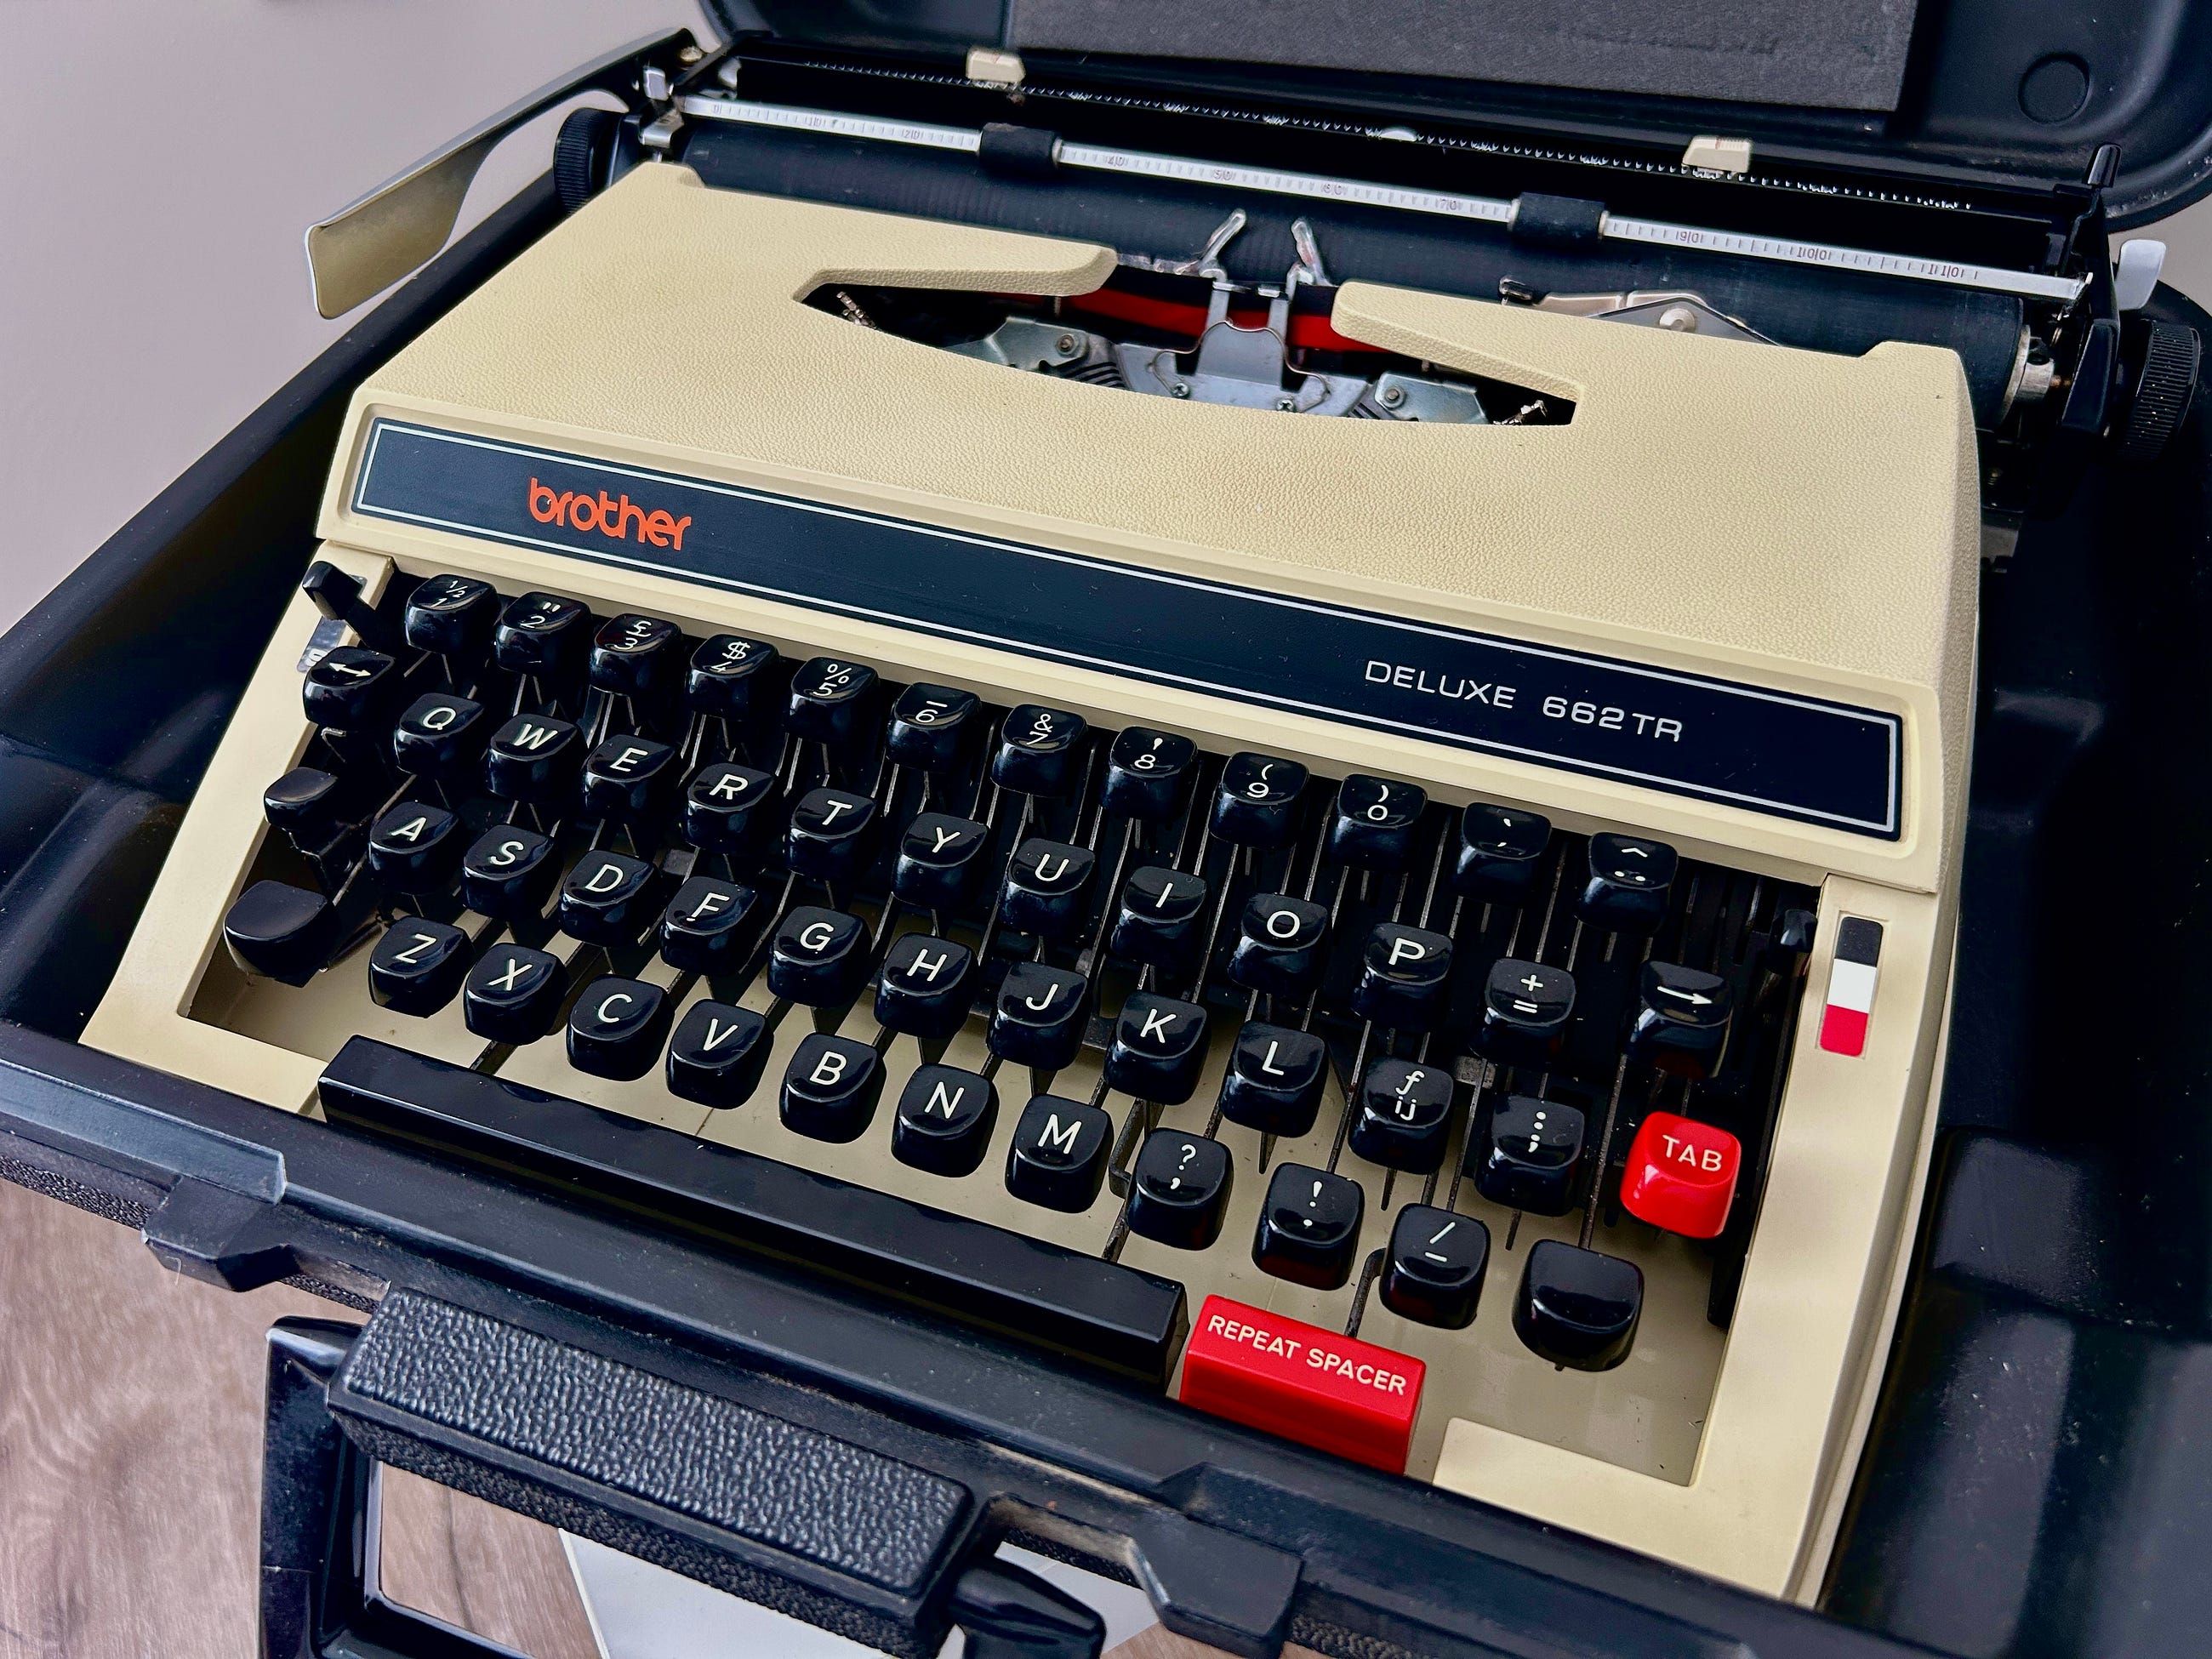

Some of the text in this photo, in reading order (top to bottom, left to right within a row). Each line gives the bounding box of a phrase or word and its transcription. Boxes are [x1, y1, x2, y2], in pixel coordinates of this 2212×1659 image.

[529, 477, 692, 550] brother
[430, 597, 448, 608] 1
[542, 601, 561, 613] "
[521, 614, 546, 630] 2
[625, 620, 653, 638] £
[613, 637, 638, 650] 3
[722, 641, 751, 660] $
[713, 660, 733, 674] 4
[824, 664, 852, 687] %
[812, 681, 836, 697] 5
[1365, 660, 1682, 742] DELUXE 662TR
[422, 707, 456, 731] Q
[915, 709, 938, 723] 6
[1033, 713, 1053, 733] &
[513, 723, 558, 750] W
[1027, 730, 1049, 746] 7
[609, 747, 648, 772] E
[1134, 754, 1156, 769] 8
[1261, 763, 1274, 780] (
[709, 773, 749, 800] R
[1246, 782, 1269, 798] 9
[1377, 784, 1389, 802] )
[822, 800, 853, 825] T
[391, 817, 427, 841] A
[932, 827, 961, 853] Y
[490, 841, 524, 865] S
[584, 864, 624, 892] D
[1035, 853, 1069, 881] U
[691, 892, 730, 921] F
[1155, 882, 1173, 908] I
[800, 922, 834, 951] G
[1266, 910, 1300, 938] O
[395, 933, 437, 964] Z
[1388, 938, 1426, 966] P
[487, 958, 533, 991] X
[906, 949, 948, 982] H
[1520, 974, 1543, 992] +
[597, 994, 633, 1023] C
[1025, 983, 1058, 1011] J
[1513, 1000, 1538, 1013] =
[703, 1018, 738, 1051] V
[1140, 1008, 1177, 1044] K
[809, 1051, 847, 1086] B
[1262, 1040, 1285, 1075] L
[924, 1081, 965, 1119] N
[1533, 1111, 1547, 1130] :
[1037, 1114, 1082, 1154] M
[1528, 1134, 1541, 1153] ;
[1178, 1144, 1196, 1171] ?
[1662, 1134, 1722, 1172] TAB
[1170, 1177, 1181, 1189] ,
[1309, 1181, 1323, 1207] !
[1429, 1222, 1456, 1244] /
[1207, 1314, 1408, 1397] REPEAT SPACER
